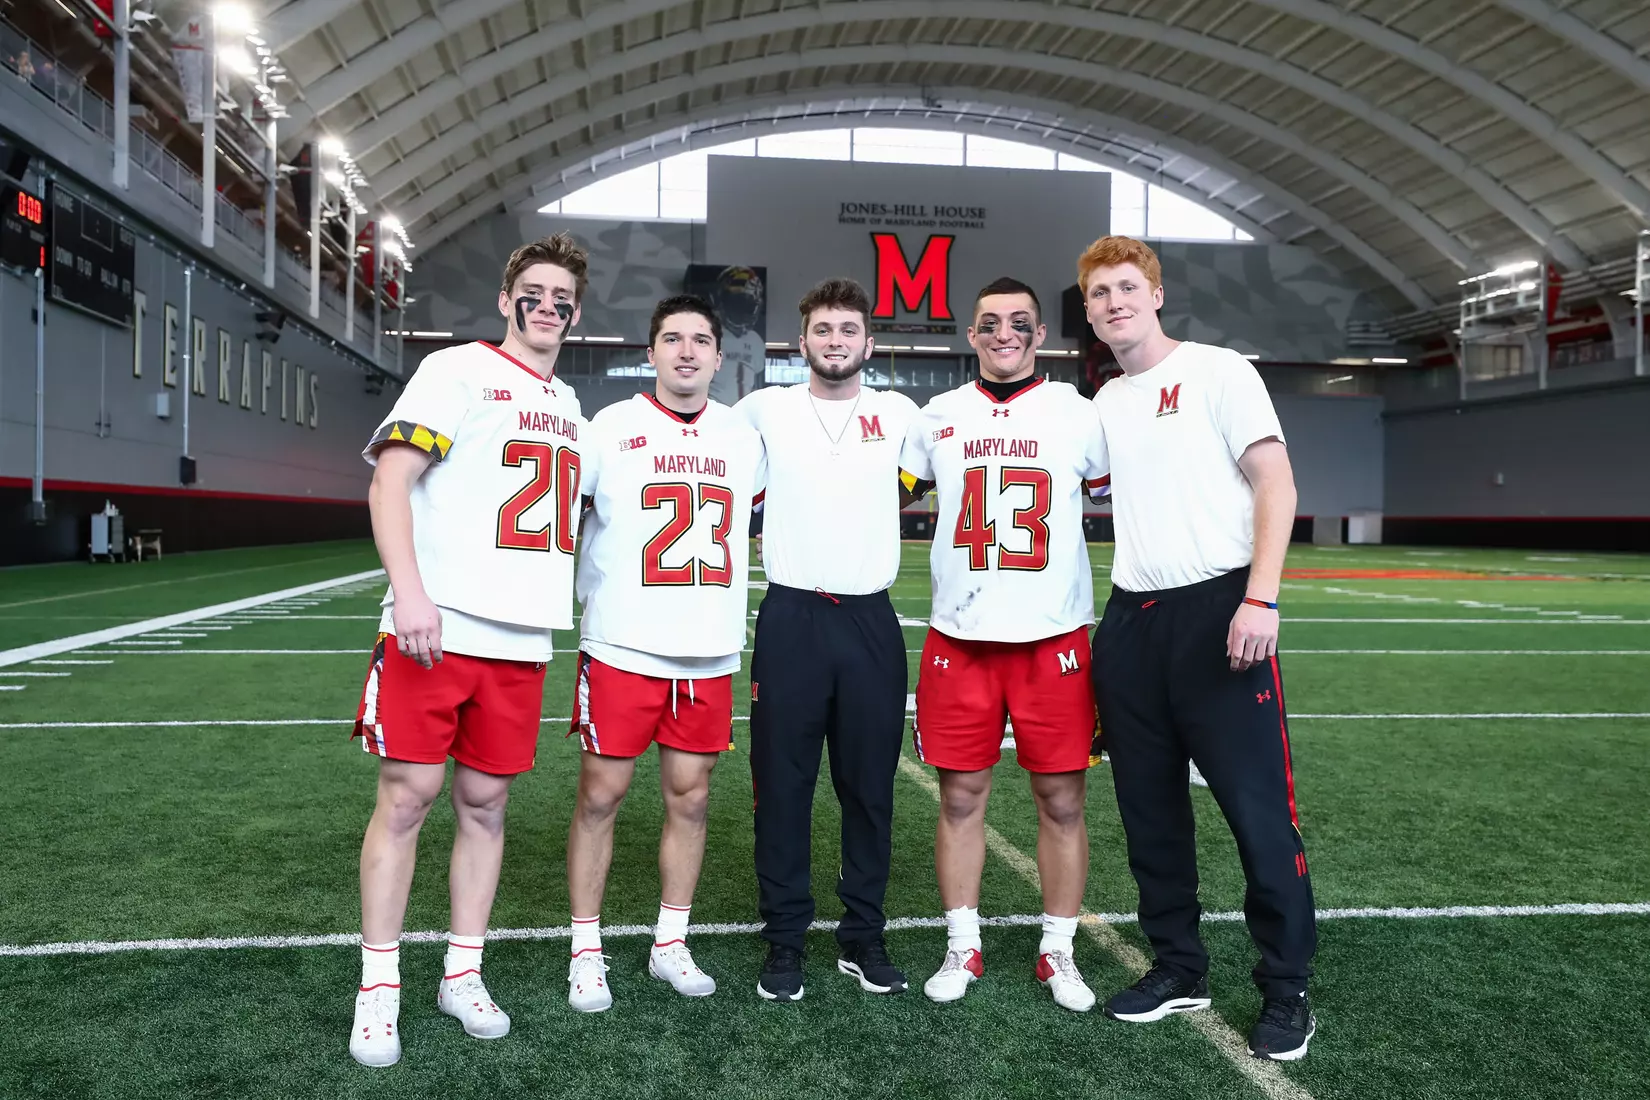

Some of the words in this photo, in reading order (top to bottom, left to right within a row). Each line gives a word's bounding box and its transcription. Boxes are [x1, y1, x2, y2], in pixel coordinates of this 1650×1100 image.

[838, 215, 867, 225] HOME
[869, 217, 882, 226] OF
[885, 218, 937, 228] MARYLAND
[939, 220, 985, 229] FOOTBALL
[839, 202, 928, 217] JONES-HILL
[933, 205, 986, 219] HOUSE
[870, 231, 956, 322] M
[132, 290, 319, 429] TERRAPINS
[1157, 383, 1182, 413] M
[518, 411, 578, 442] MARYLAND
[858, 415, 885, 439] M
[963, 438, 1039, 460] MARYLAND
[653, 455, 726, 478] MARYLAND
[495, 439, 582, 556] 20
[953, 465, 1052, 571] 43
[641, 482, 734, 588] 23
[1057, 649, 1080, 674] M
